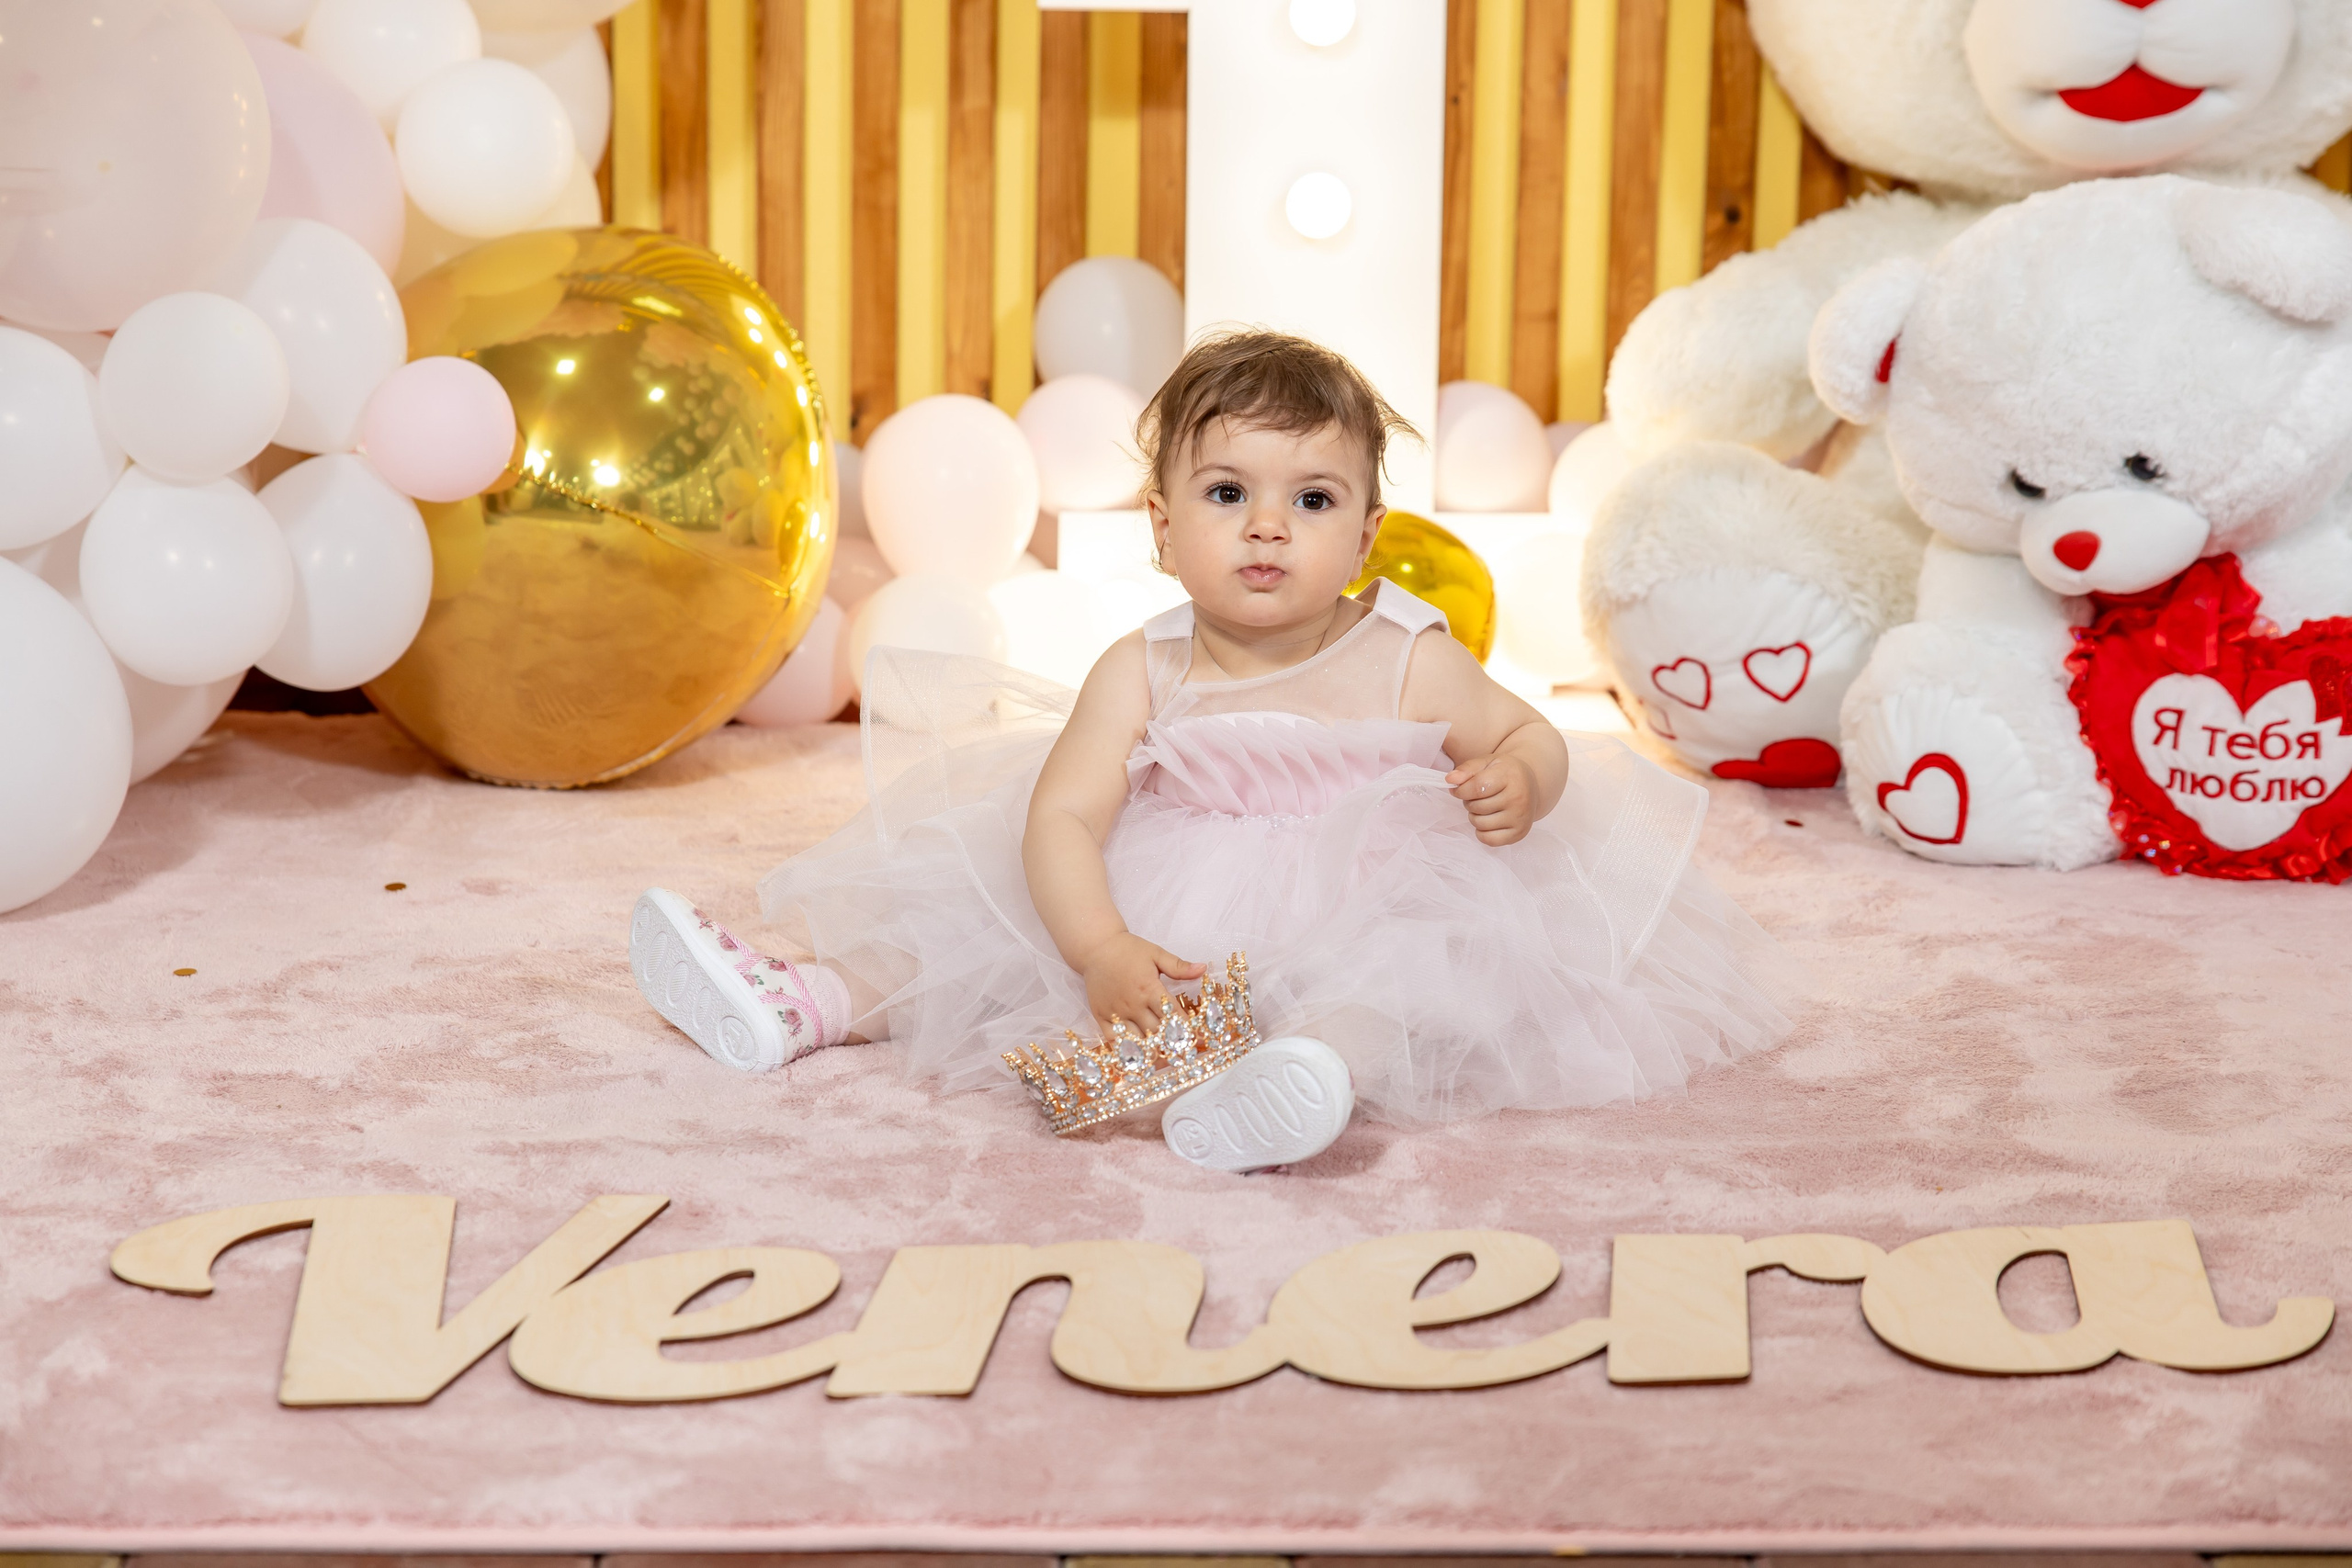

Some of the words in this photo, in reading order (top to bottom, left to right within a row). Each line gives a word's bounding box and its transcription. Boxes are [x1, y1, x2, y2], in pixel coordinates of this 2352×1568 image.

[2152, 707, 2186, 750] Я
[2201, 718, 2322, 761] тебя
[2165, 767, 2327, 803] люблю
[108, 1194, 2335, 1408] Venera
